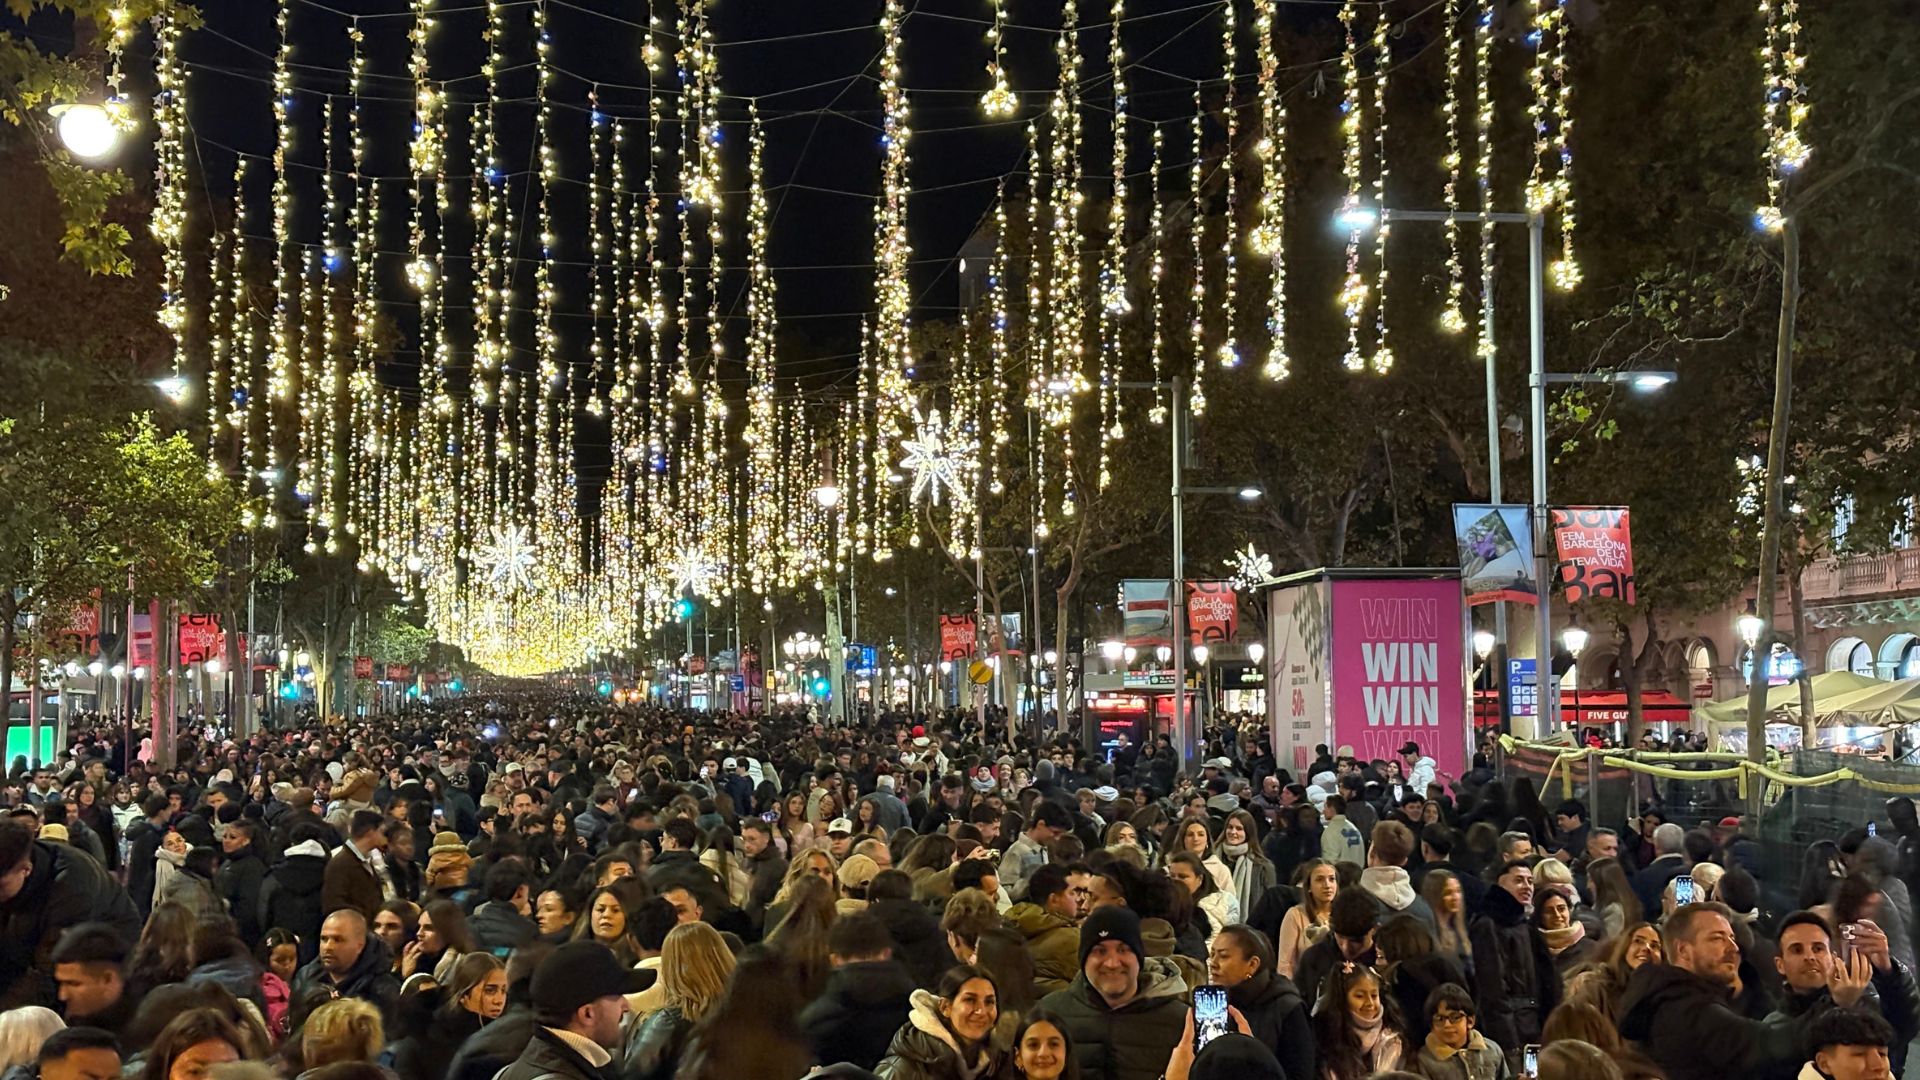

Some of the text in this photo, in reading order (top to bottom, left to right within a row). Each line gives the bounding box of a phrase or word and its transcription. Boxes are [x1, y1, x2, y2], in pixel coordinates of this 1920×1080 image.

[1561, 531, 1609, 541] FEM LA
[1563, 540, 1627, 553] BARCELONA
[1597, 549, 1626, 561] DE LA
[1569, 556, 1624, 569] TEVA VIDA
[1360, 599, 1438, 639] WIN
[1361, 643, 1438, 682] WIN
[1511, 661, 1522, 674] P
[1362, 687, 1439, 726] WIN
[1588, 711, 1629, 719] FIVE GU
